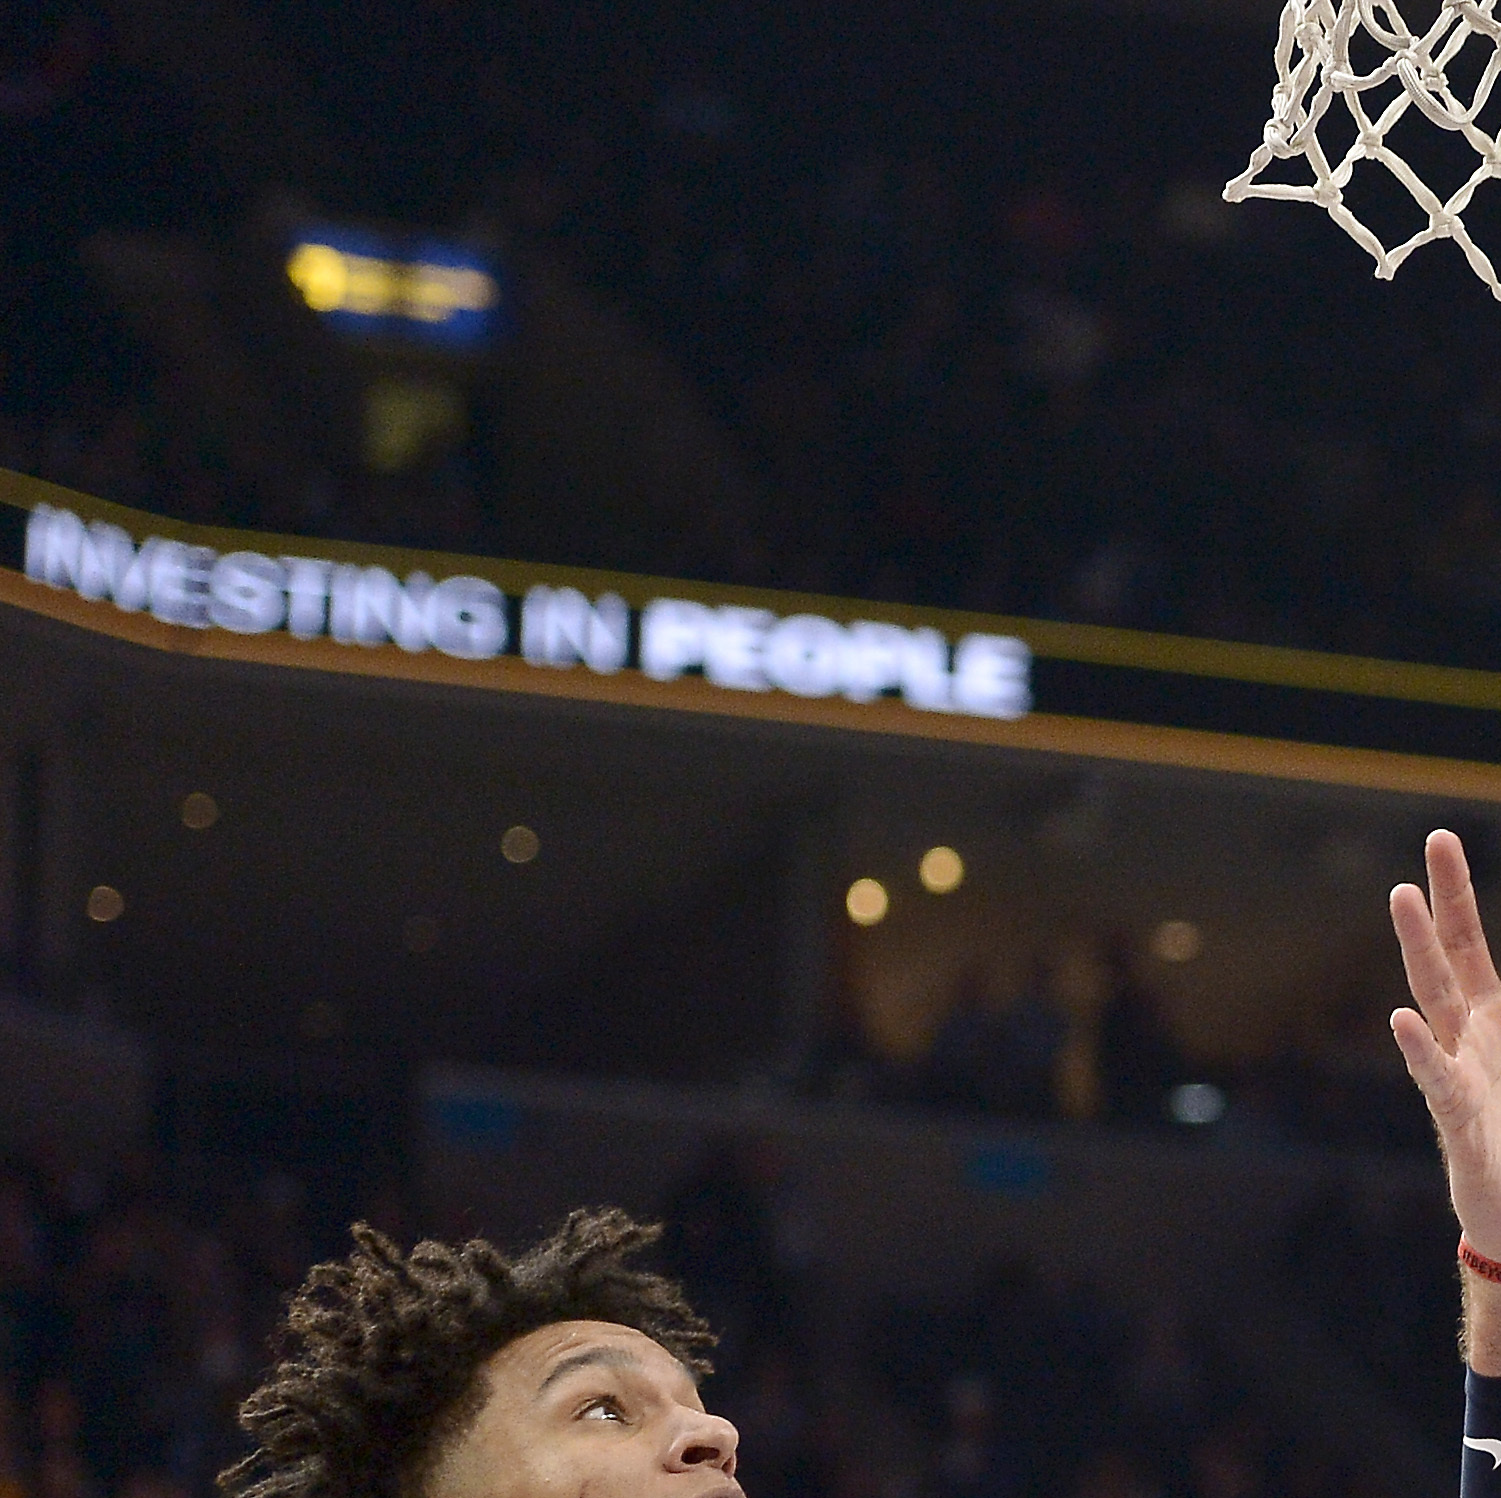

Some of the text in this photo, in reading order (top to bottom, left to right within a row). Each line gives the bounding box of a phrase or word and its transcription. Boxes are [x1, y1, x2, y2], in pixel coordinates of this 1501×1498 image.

[24, 502, 1032, 721] INVESTING IN PEOPLE
